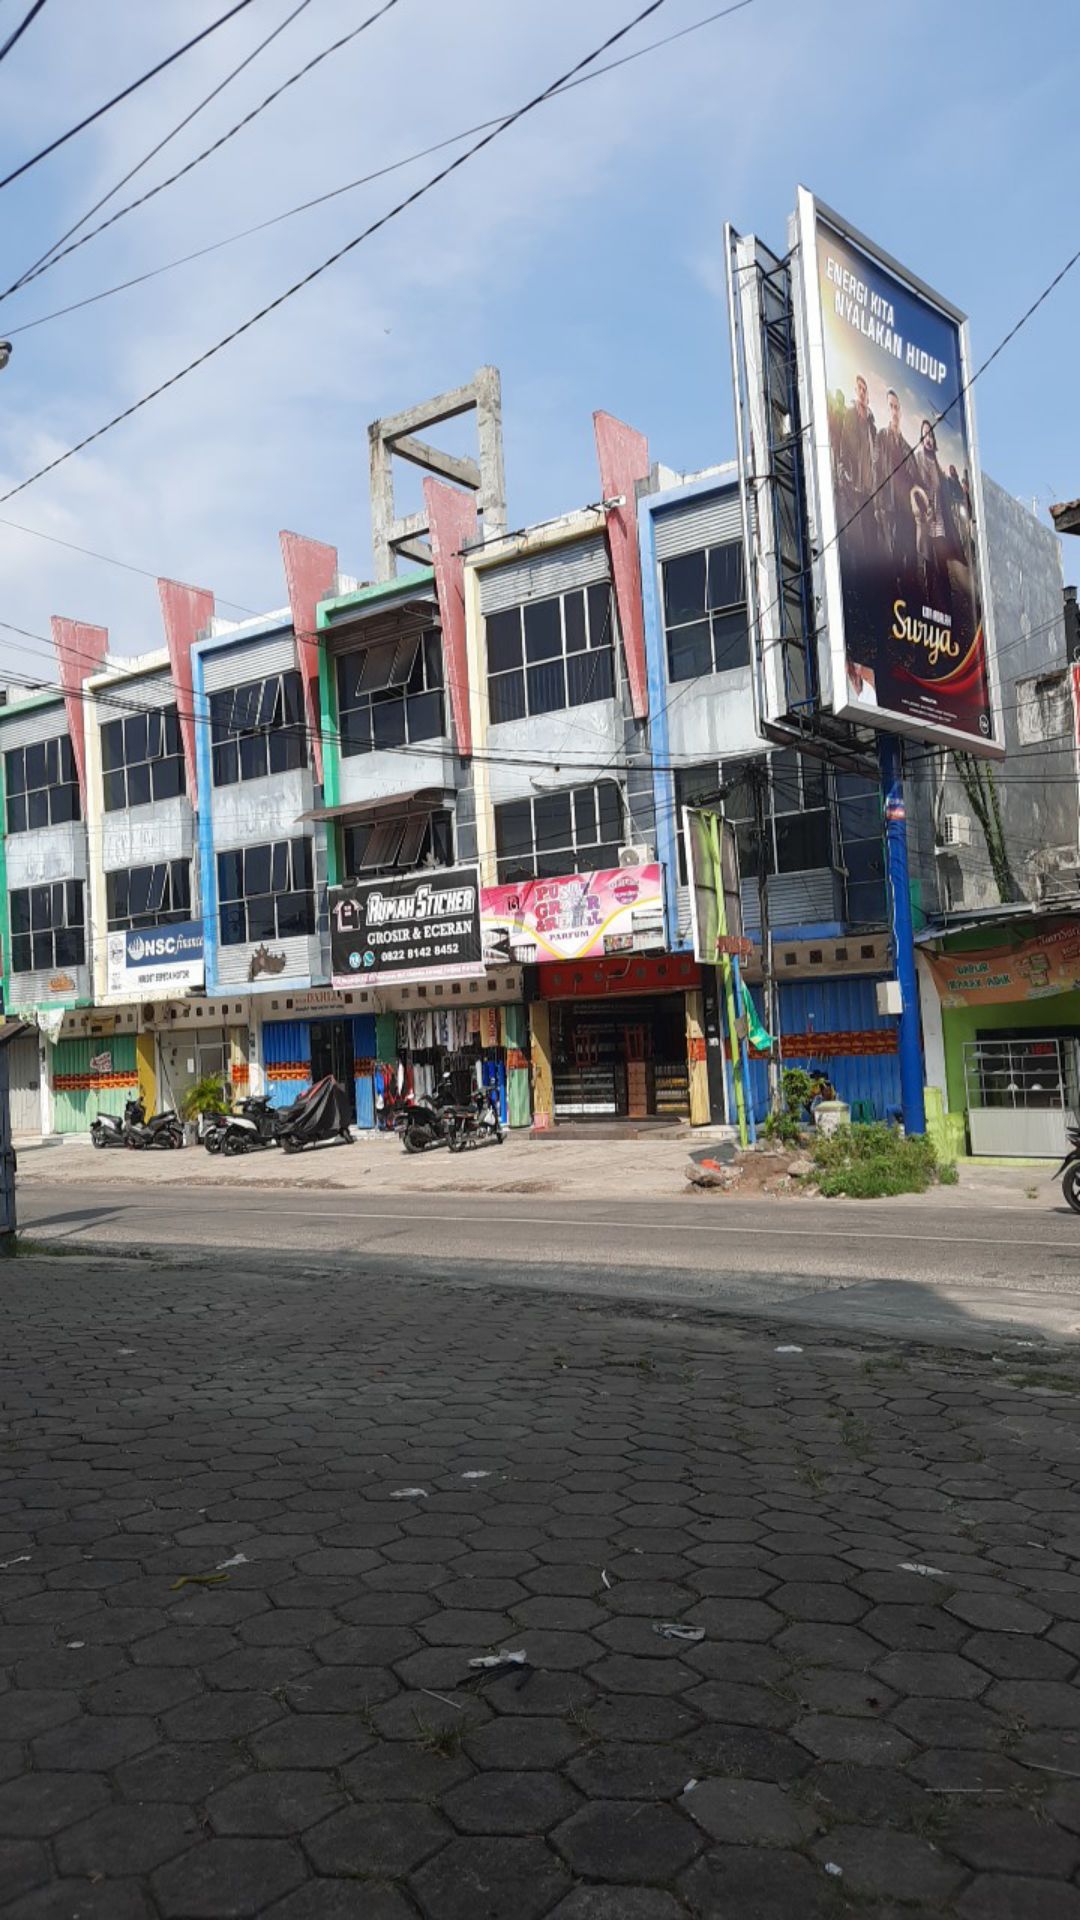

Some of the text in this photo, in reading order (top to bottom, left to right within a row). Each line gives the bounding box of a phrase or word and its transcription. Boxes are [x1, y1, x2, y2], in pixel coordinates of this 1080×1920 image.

[826, 257, 895, 327] ENERGI KITA
[834, 292, 947, 385] NYALAKAN HIDUP
[892, 599, 960, 665] Surya
[366, 892, 415, 926] RUMAH
[145, 936, 175, 957] NSC
[367, 920, 472, 945] GROSIR & ECERAN
[549, 930, 590, 942] PARFUM
[381, 943, 459, 962] 0822 8142 8452
